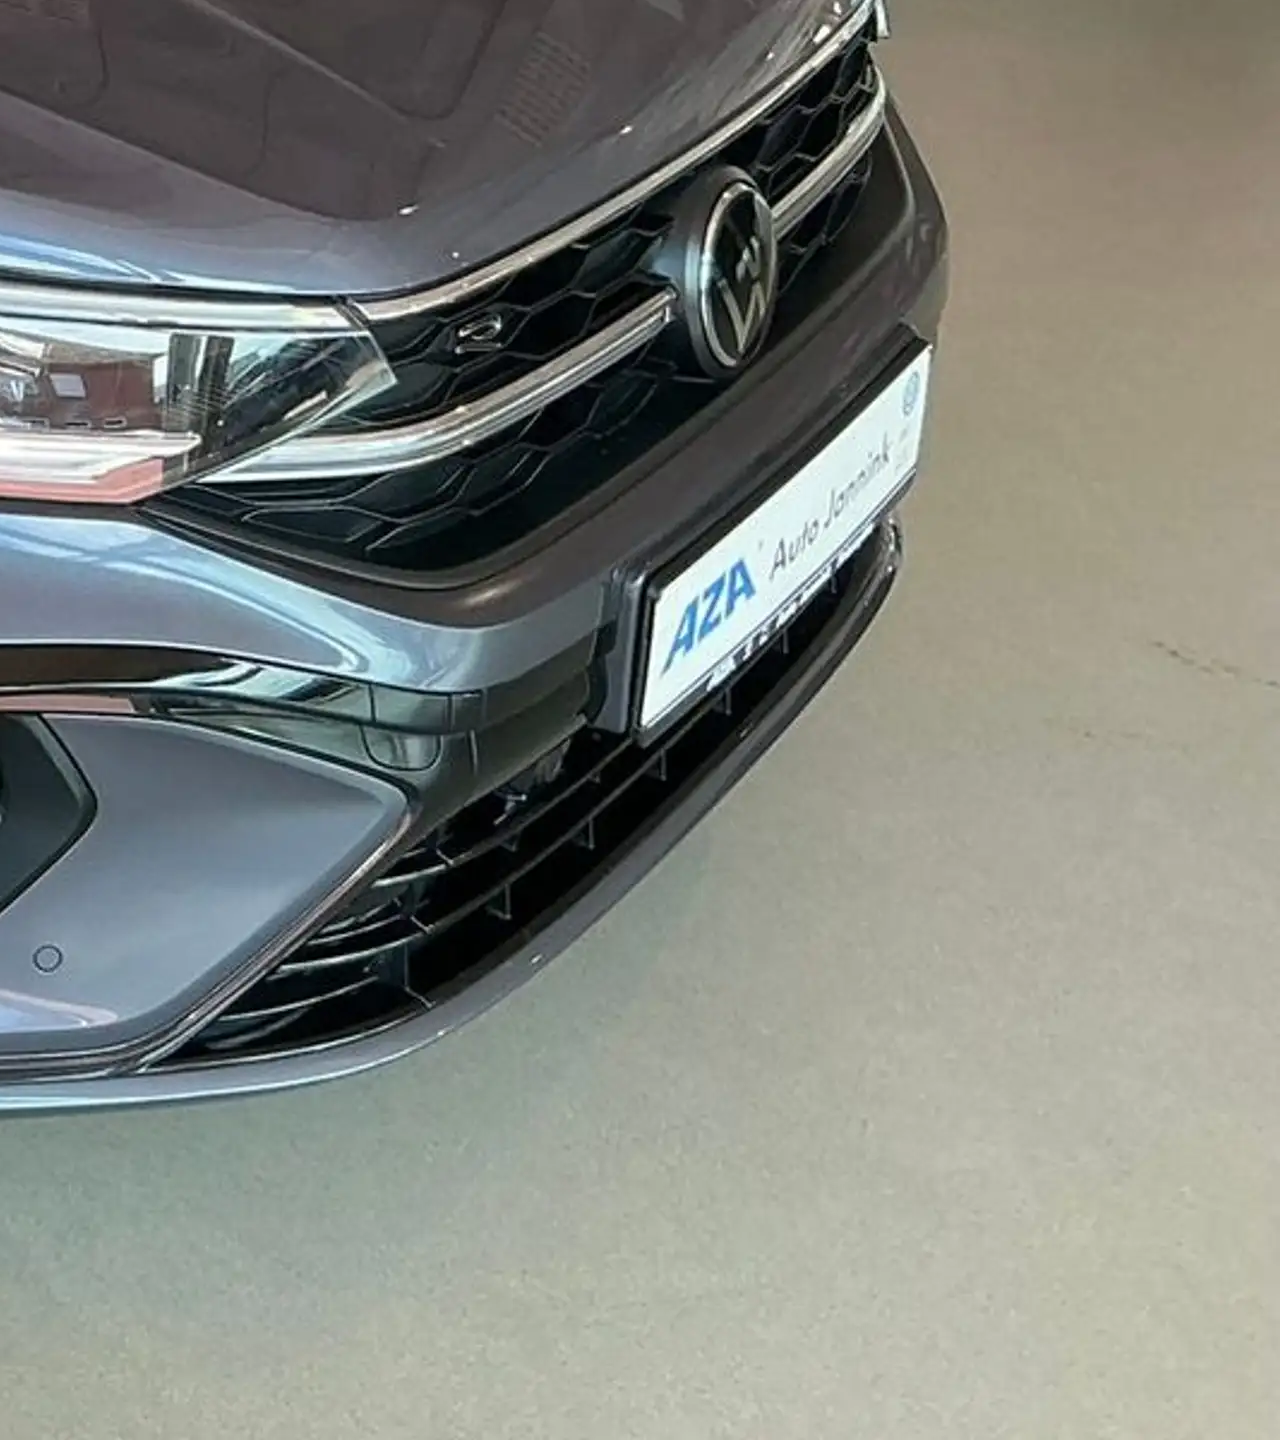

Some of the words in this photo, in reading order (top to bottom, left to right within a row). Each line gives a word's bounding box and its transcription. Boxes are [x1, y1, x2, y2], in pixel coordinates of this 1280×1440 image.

[659, 557, 757, 678] AZA
[768, 517, 820, 581] Auto
[824, 430, 891, 528] Jannink
